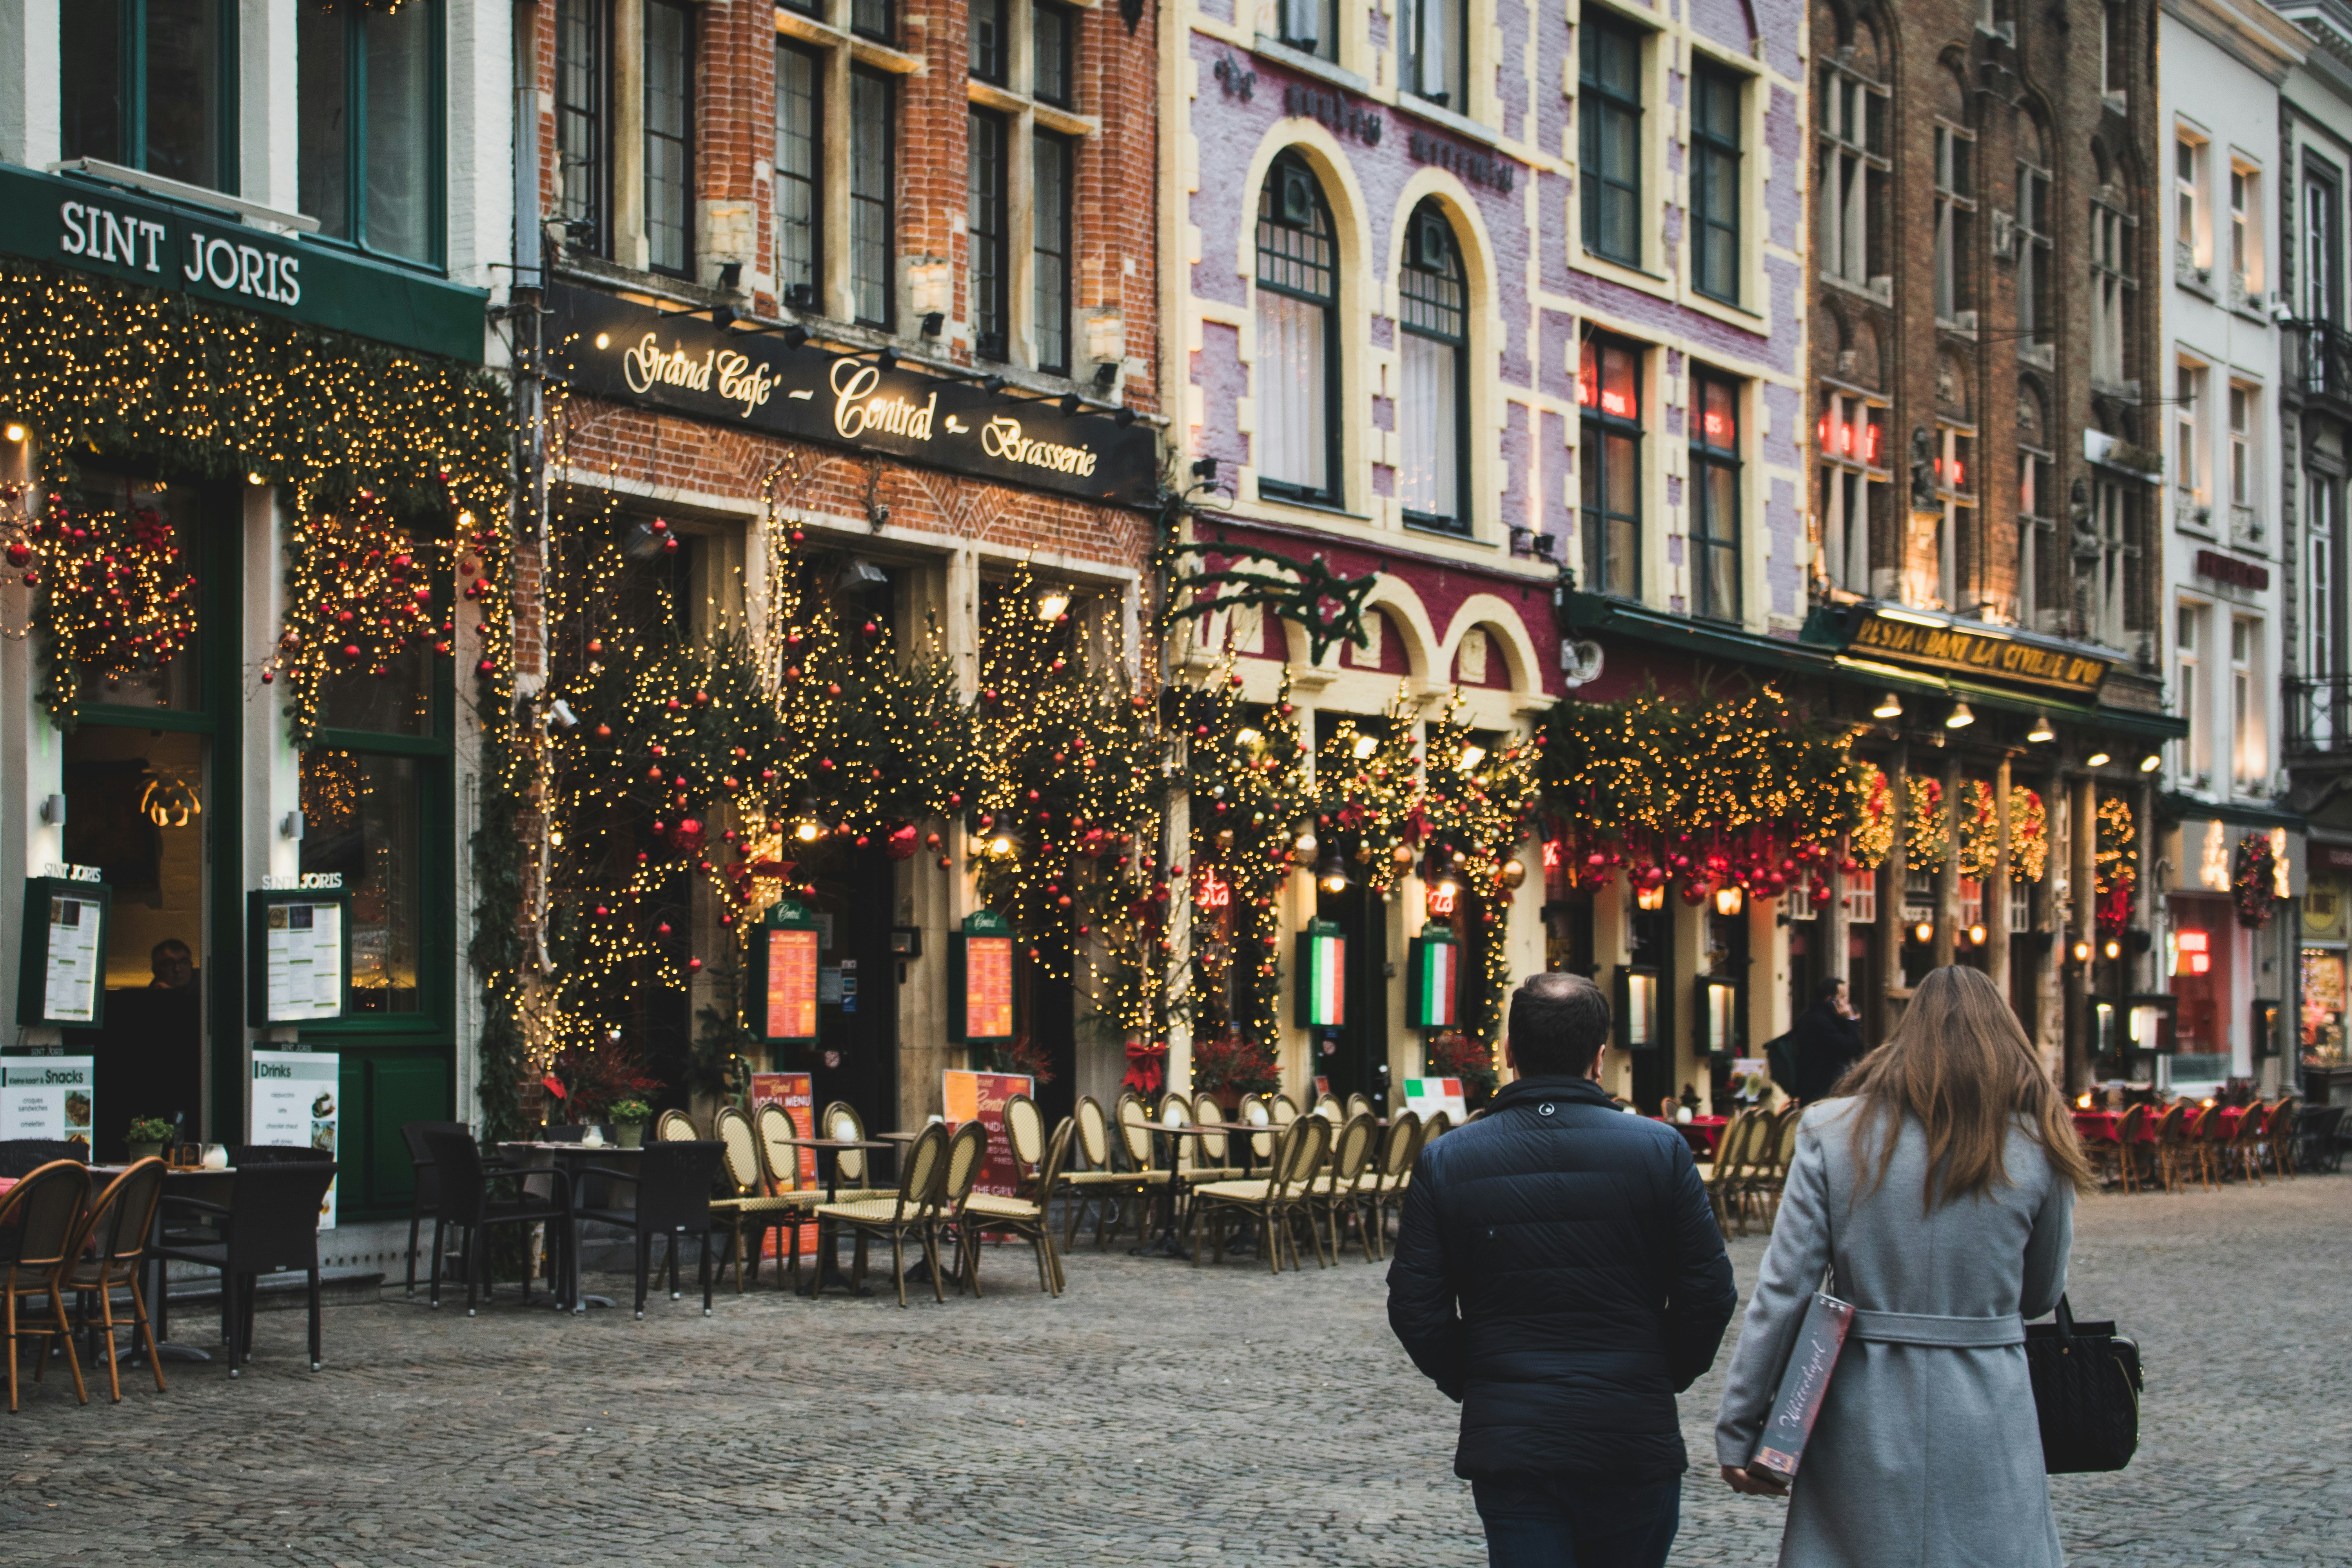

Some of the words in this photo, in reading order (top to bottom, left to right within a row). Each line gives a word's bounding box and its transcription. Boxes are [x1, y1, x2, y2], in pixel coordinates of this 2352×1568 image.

[60, 201, 165, 273] SINT
[184, 232, 300, 306] JORIS
[624, 332, 715, 394] Grand
[830, 358, 937, 441] Central
[981, 414, 1097, 477] Brasserie
[1857, 617, 1972, 661] RESTAURANT
[1970, 639, 1999, 666] LA
[44, 862, 70, 879] SINT
[70, 864, 102, 883] JORIS
[262, 874, 297, 890] SINT
[299, 872, 342, 889] JORIS
[45, 1069, 83, 1084] Snacks
[260, 1063, 291, 1078] Drinks
[785, 1096, 811, 1107] MENU
[972, 1184, 991, 1195] THE
[1779, 1339, 1826, 1428] Whitechapel
